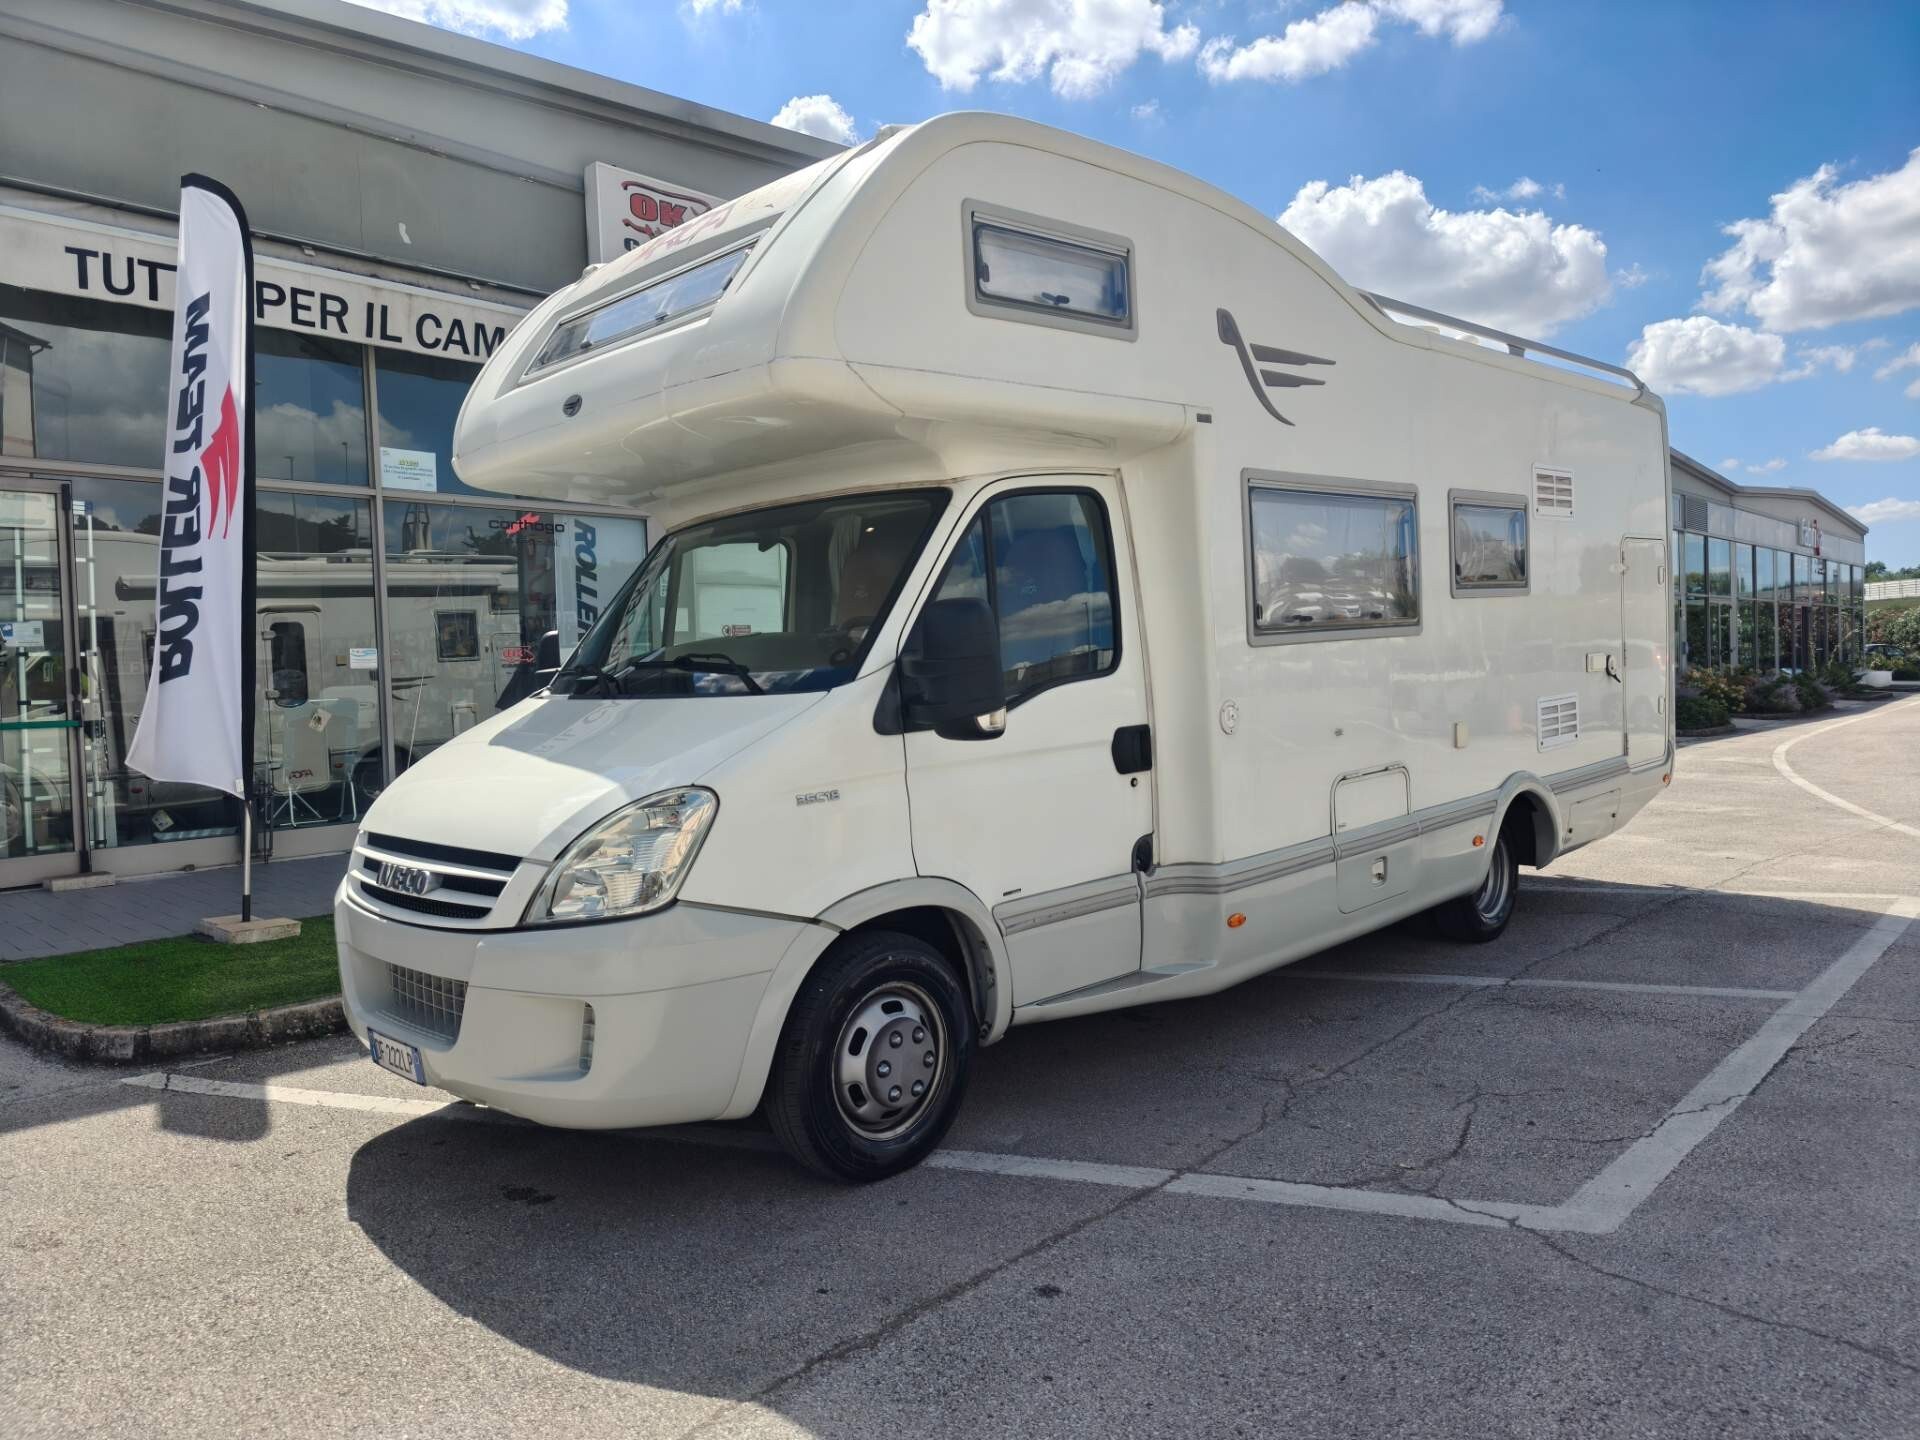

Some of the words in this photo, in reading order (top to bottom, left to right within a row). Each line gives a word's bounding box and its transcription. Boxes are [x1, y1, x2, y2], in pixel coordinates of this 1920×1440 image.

[65, 246, 178, 301] TUT
[255, 280, 349, 334] PER
[366, 302, 403, 343] IL
[415, 313, 507, 358] CAM
[376, 862, 430, 895] IVECO
